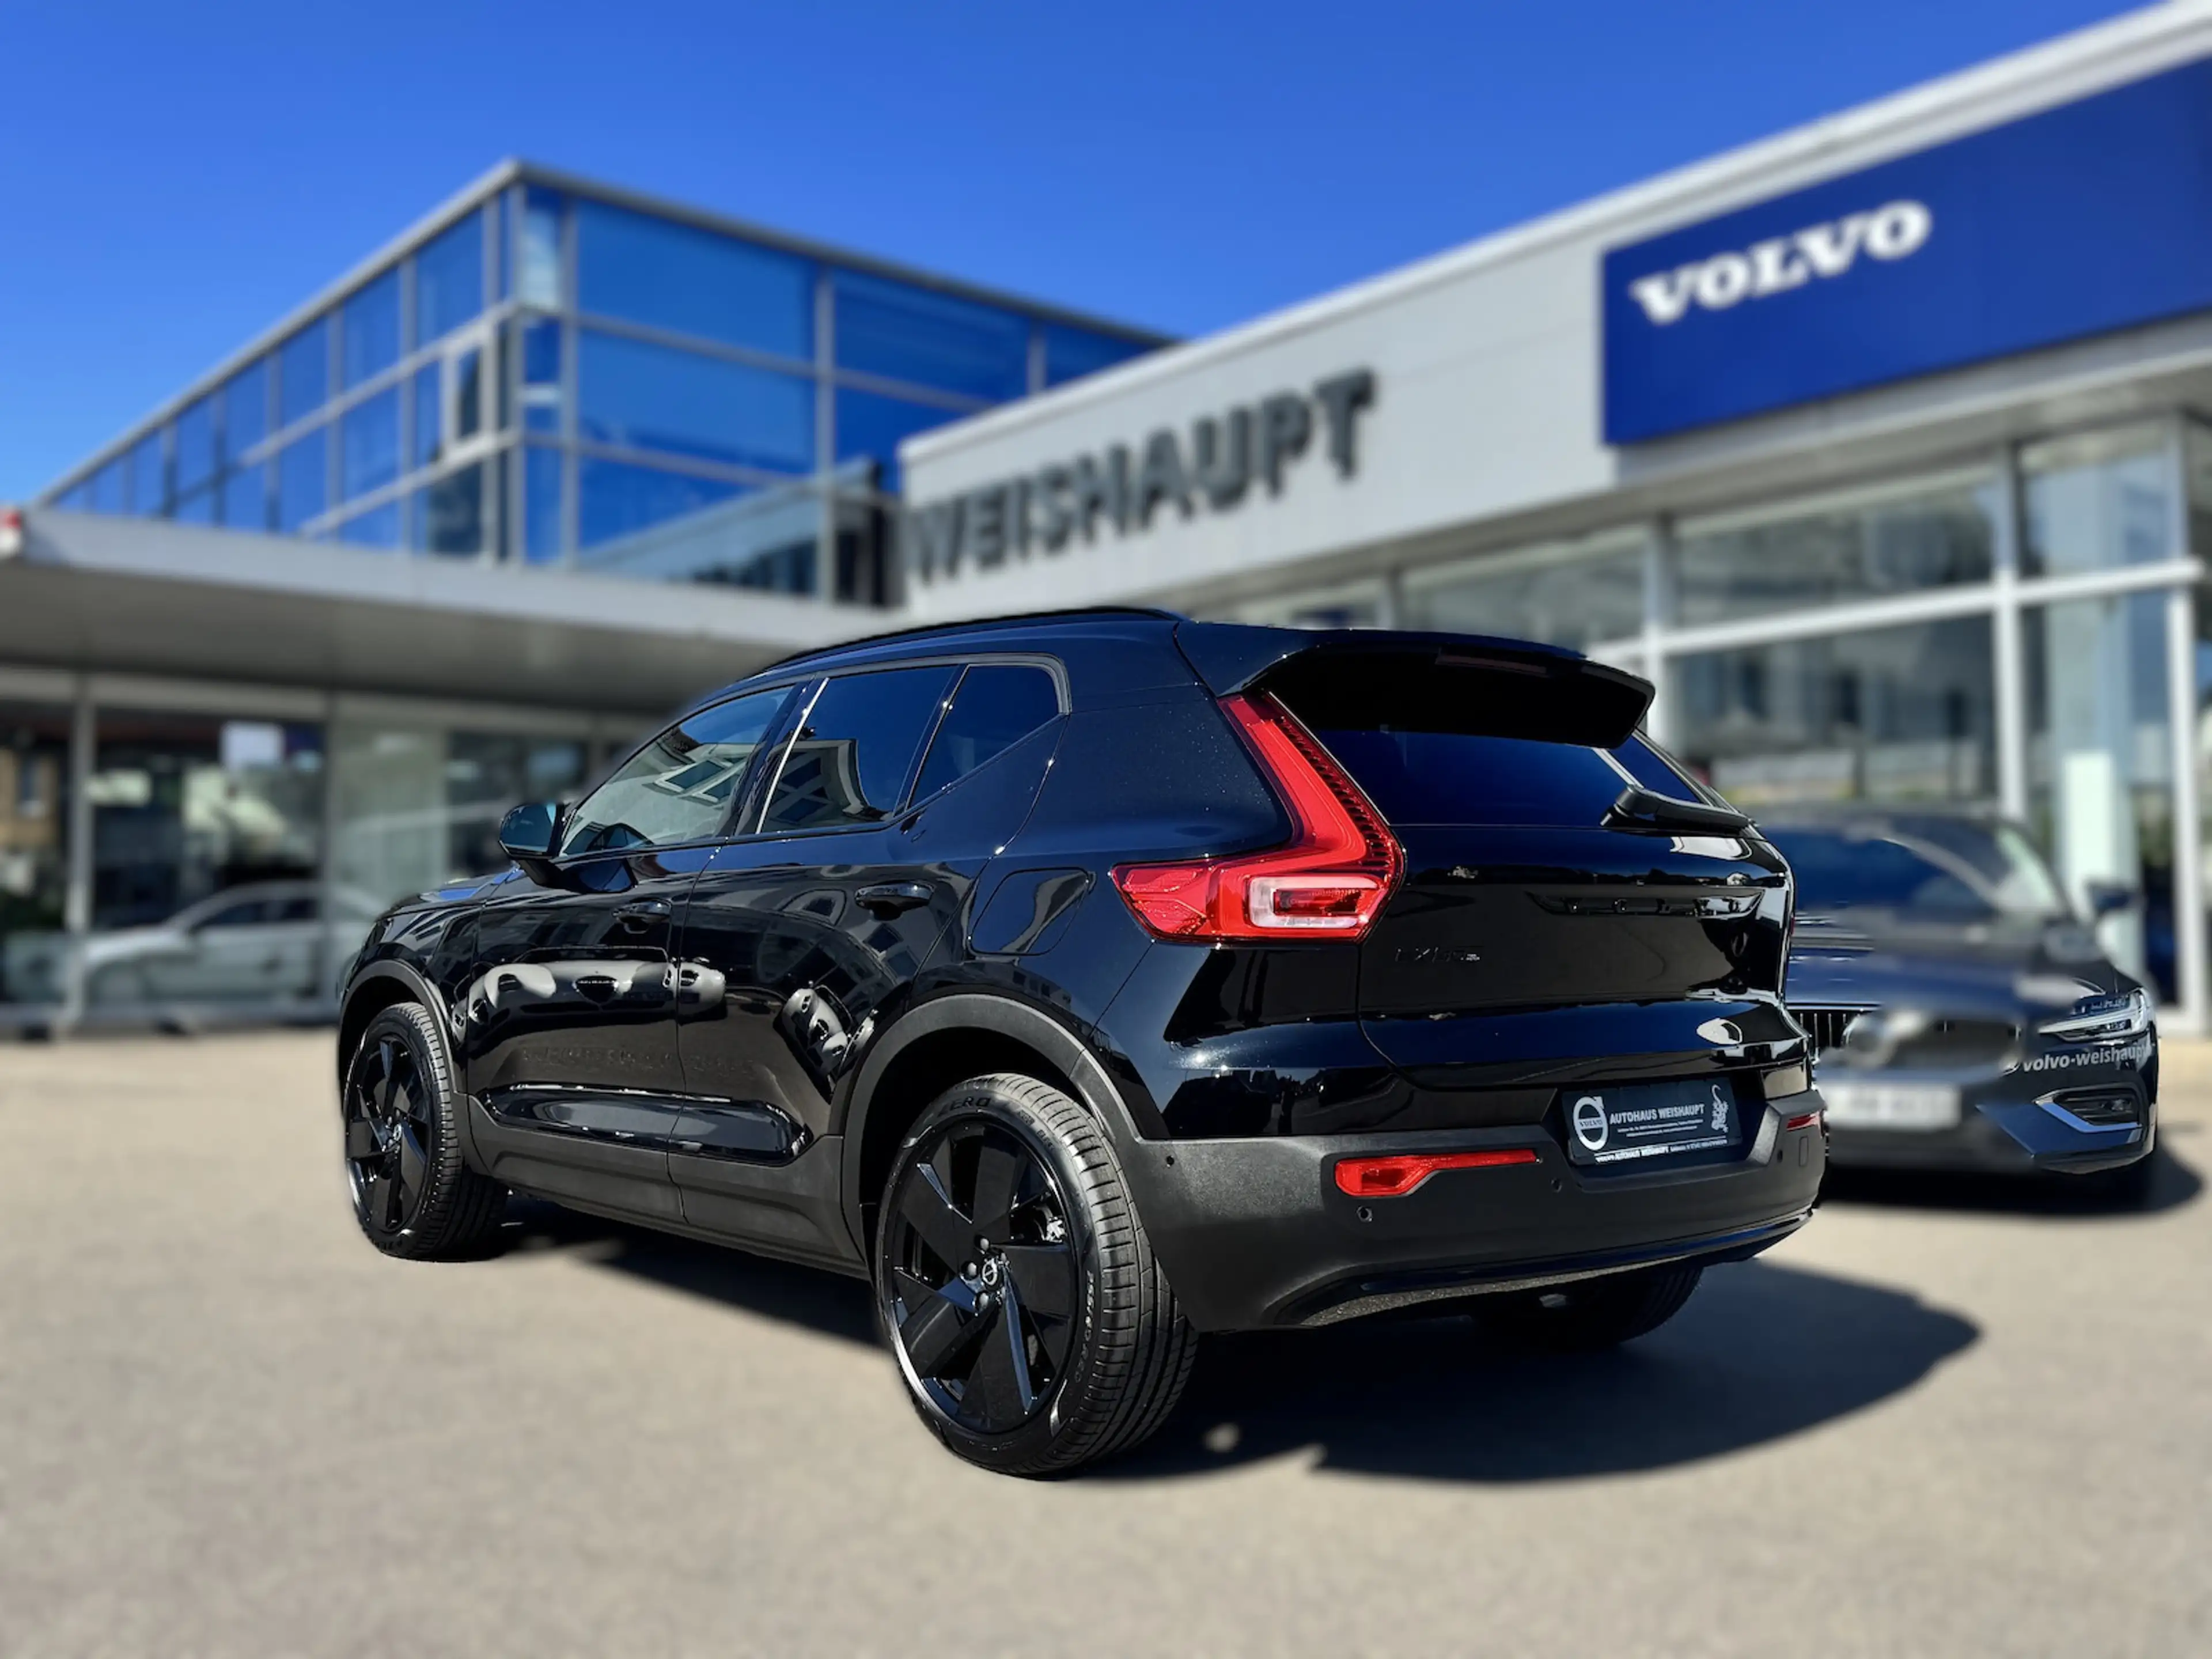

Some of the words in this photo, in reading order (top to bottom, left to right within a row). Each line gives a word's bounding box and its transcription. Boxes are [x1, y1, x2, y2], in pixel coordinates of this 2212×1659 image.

[1631, 201, 1931, 324] VOLVO
[903, 366, 1375, 584] WEISHAUPT
[1609, 1109, 1657, 1124] AUTOHAUS
[1658, 1104, 1705, 1119] WEISHAUPT
